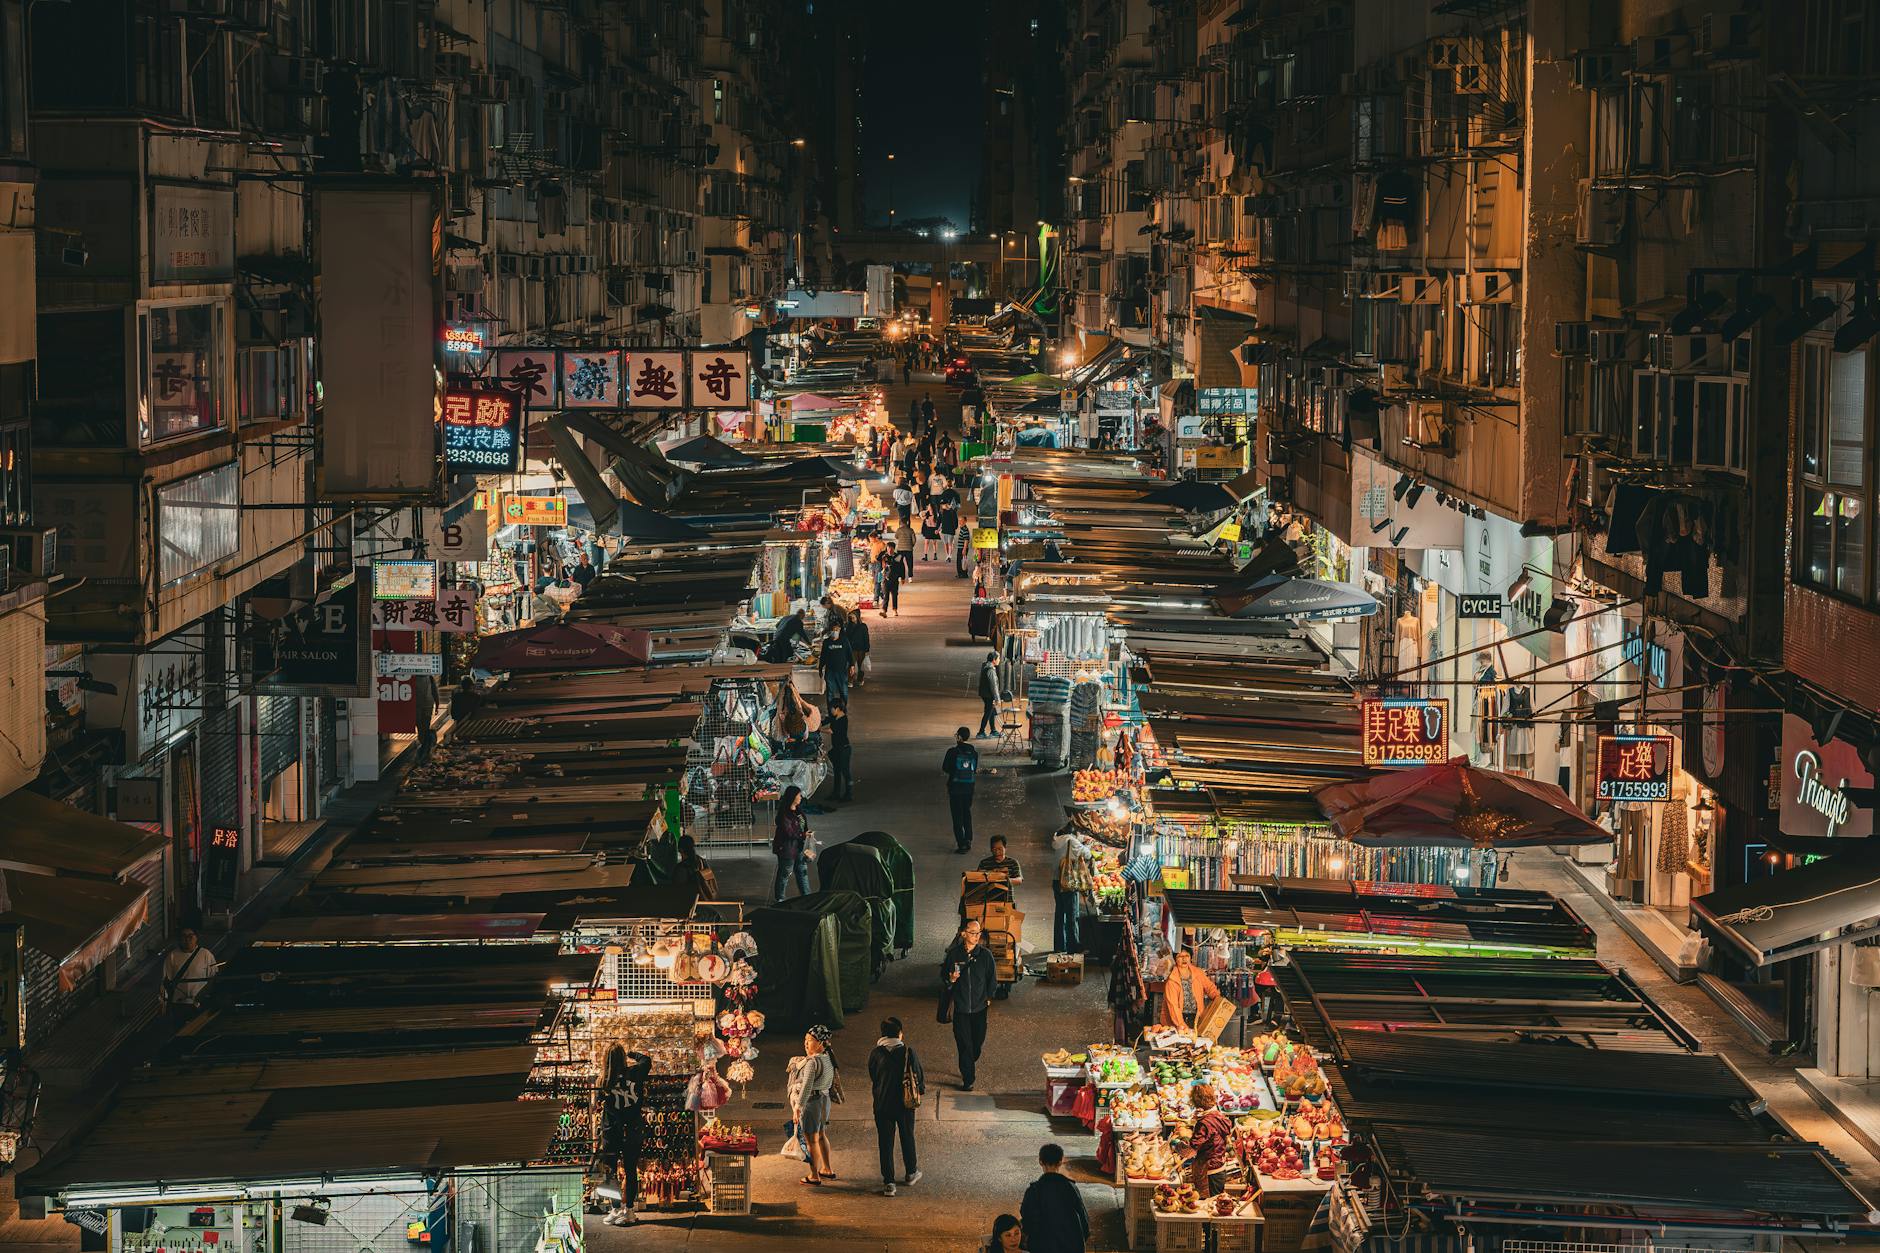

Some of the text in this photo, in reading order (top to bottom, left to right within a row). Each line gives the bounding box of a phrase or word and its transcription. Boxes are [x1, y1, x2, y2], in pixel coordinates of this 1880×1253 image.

[443, 525, 463, 547] B
[1462, 599, 1500, 614] CYCLE
[301, 650, 338, 661] SALON
[377, 681, 412, 702] ale
[1369, 704, 1420, 743] 美足樂
[1369, 745, 1442, 760] 91755993
[1600, 781, 1667, 798] 91755993
[1795, 750, 1848, 837] Triangle
